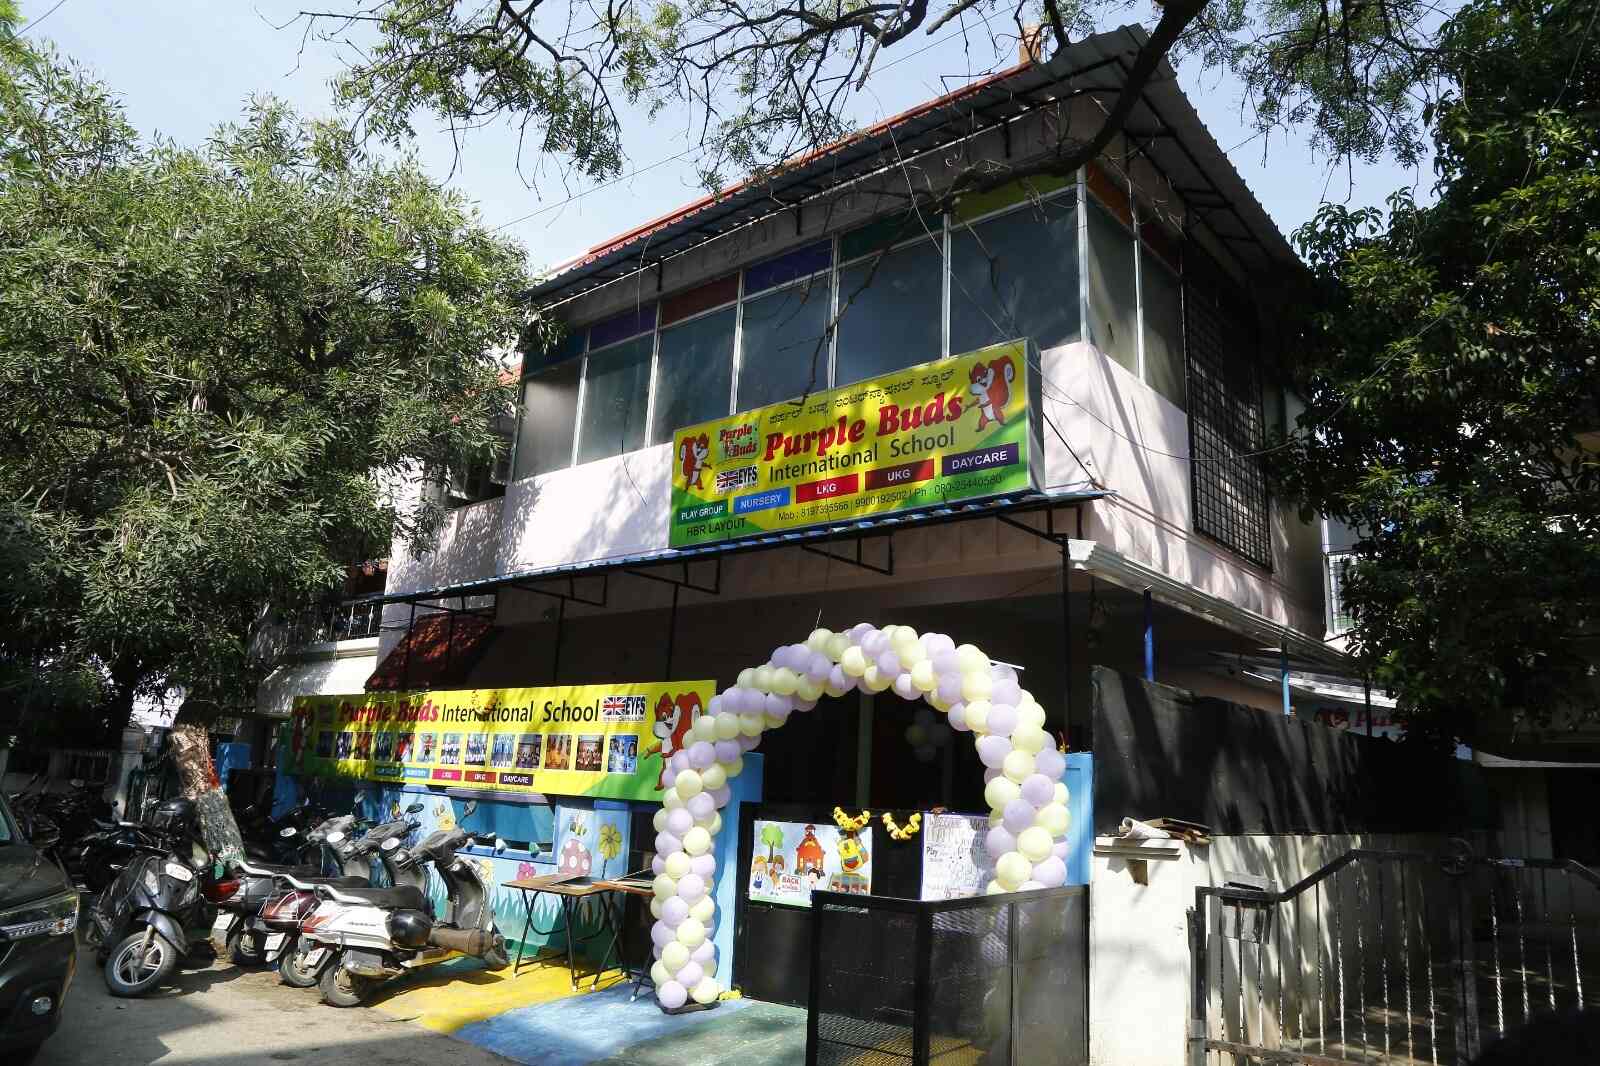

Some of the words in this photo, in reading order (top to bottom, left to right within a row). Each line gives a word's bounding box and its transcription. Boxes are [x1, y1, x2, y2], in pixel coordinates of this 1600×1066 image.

[719, 424, 753, 441] Purple
[764, 415, 866, 461] Purple
[876, 392, 964, 437] Buds
[769, 443, 878, 483] International
[889, 427, 955, 458] School
[952, 449, 1008, 470] DAYCARE
[738, 466, 758, 485] EYFS
[887, 469, 911, 481] UKG
[816, 482, 837, 495] LKG
[740, 493, 782, 509] NURSERY
[681, 510, 698, 521] PLAY
[699, 505, 724, 517] GROUP
[687, 524, 706, 537] HBR
[709, 517, 746, 534] LAYOUT
[398, 699, 439, 721] Buds
[542, 699, 600, 722] School
[625, 696, 646, 715] EYFS
[474, 773, 486, 781] UKG
[502, 775, 529, 784] DAYCARE
